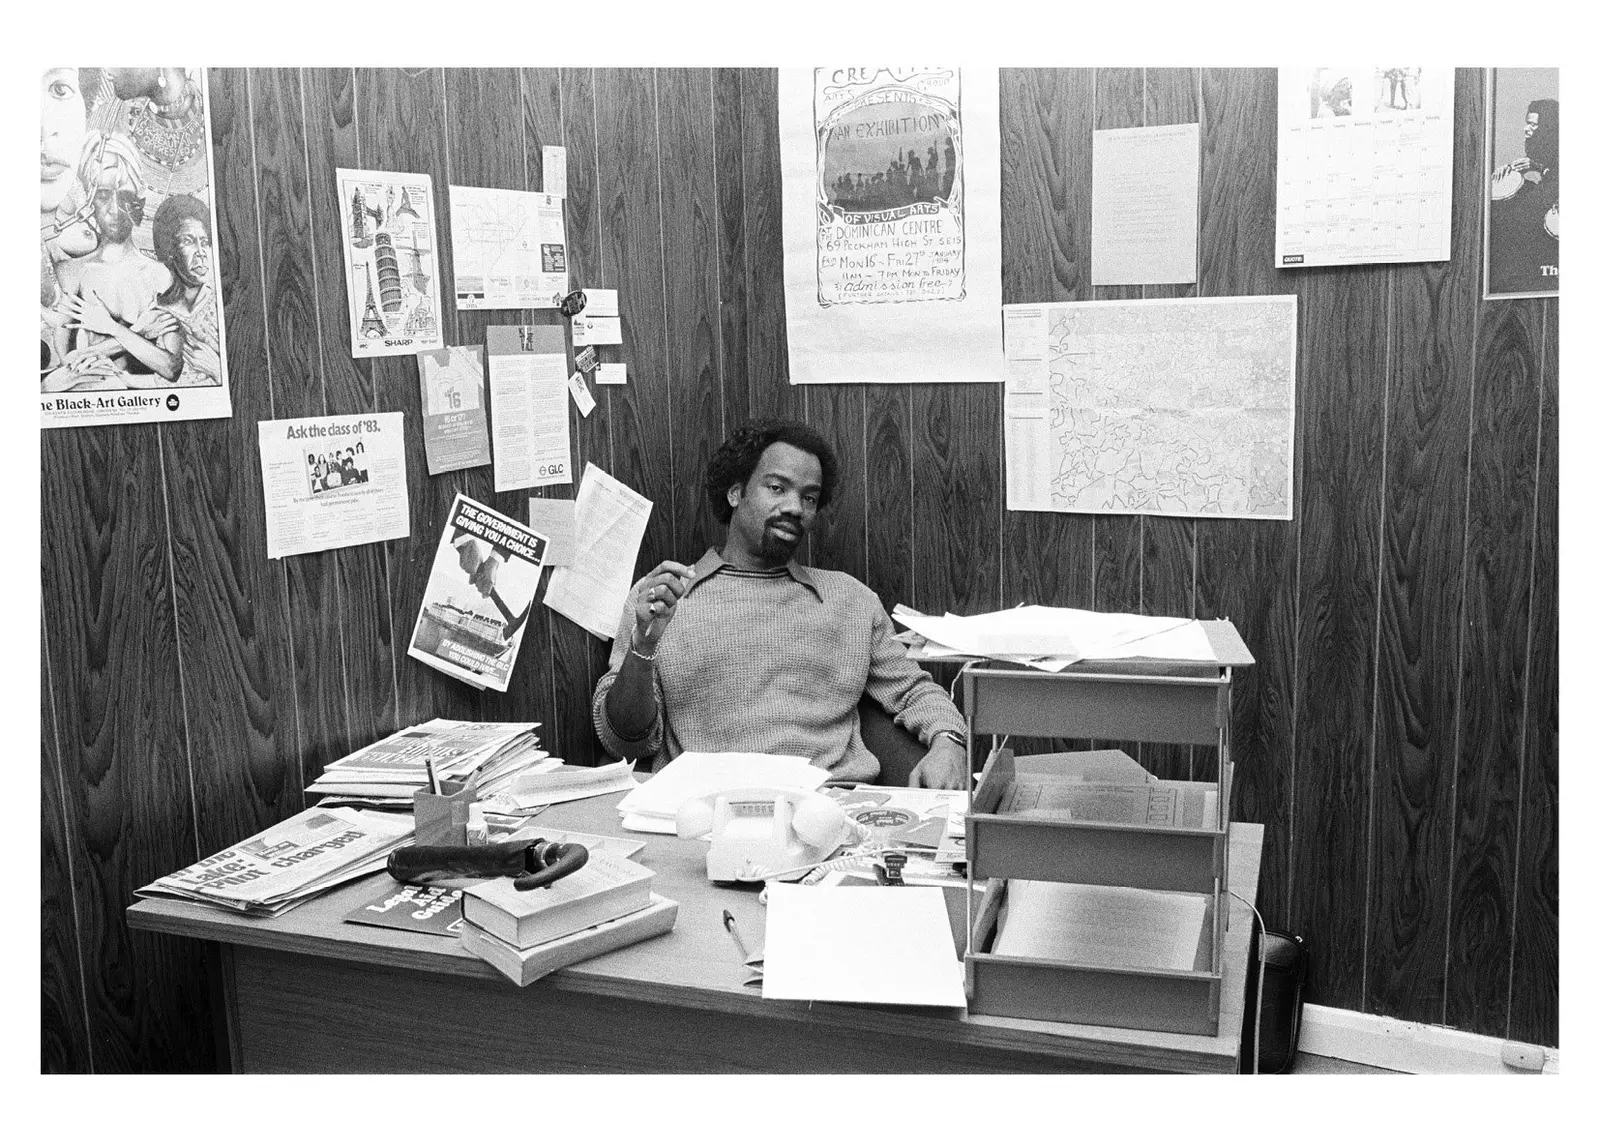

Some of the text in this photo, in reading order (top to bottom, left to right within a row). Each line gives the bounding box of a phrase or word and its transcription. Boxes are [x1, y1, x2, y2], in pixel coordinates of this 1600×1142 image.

[856, 114, 941, 138] EXHIBITION
[844, 203, 938, 224] OF VISUAL ARTS
[836, 220, 944, 240] DOMINICAN CENTRE
[826, 240, 841, 252] 69
[843, 239, 888, 251] PECKHAM
[893, 238, 917, 248] HIGH
[931, 265, 961, 278] FRIDAY
[844, 279, 916, 292] admission
[384, 339, 413, 347] SHARP
[56, 397, 114, 411] Black-Art
[117, 395, 161, 407] Gallery
[287, 425, 308, 439] Ask
[309, 424, 326, 438] the
[328, 422, 350, 436] class
[352, 420, 363, 434] of
[548, 464, 564, 475] GLC
[456, 515, 484, 535] GIVING
[484, 527, 502, 543] YOU
[499, 536, 507, 546] A
[460, 504, 538, 547] THE GOVERNMENT IS
[270, 830, 367, 869] charged
[179, 858, 255, 886] Lake:
[366, 885, 423, 912] Legal
[410, 887, 447, 907] Aid
[412, 890, 463, 920] Guide
